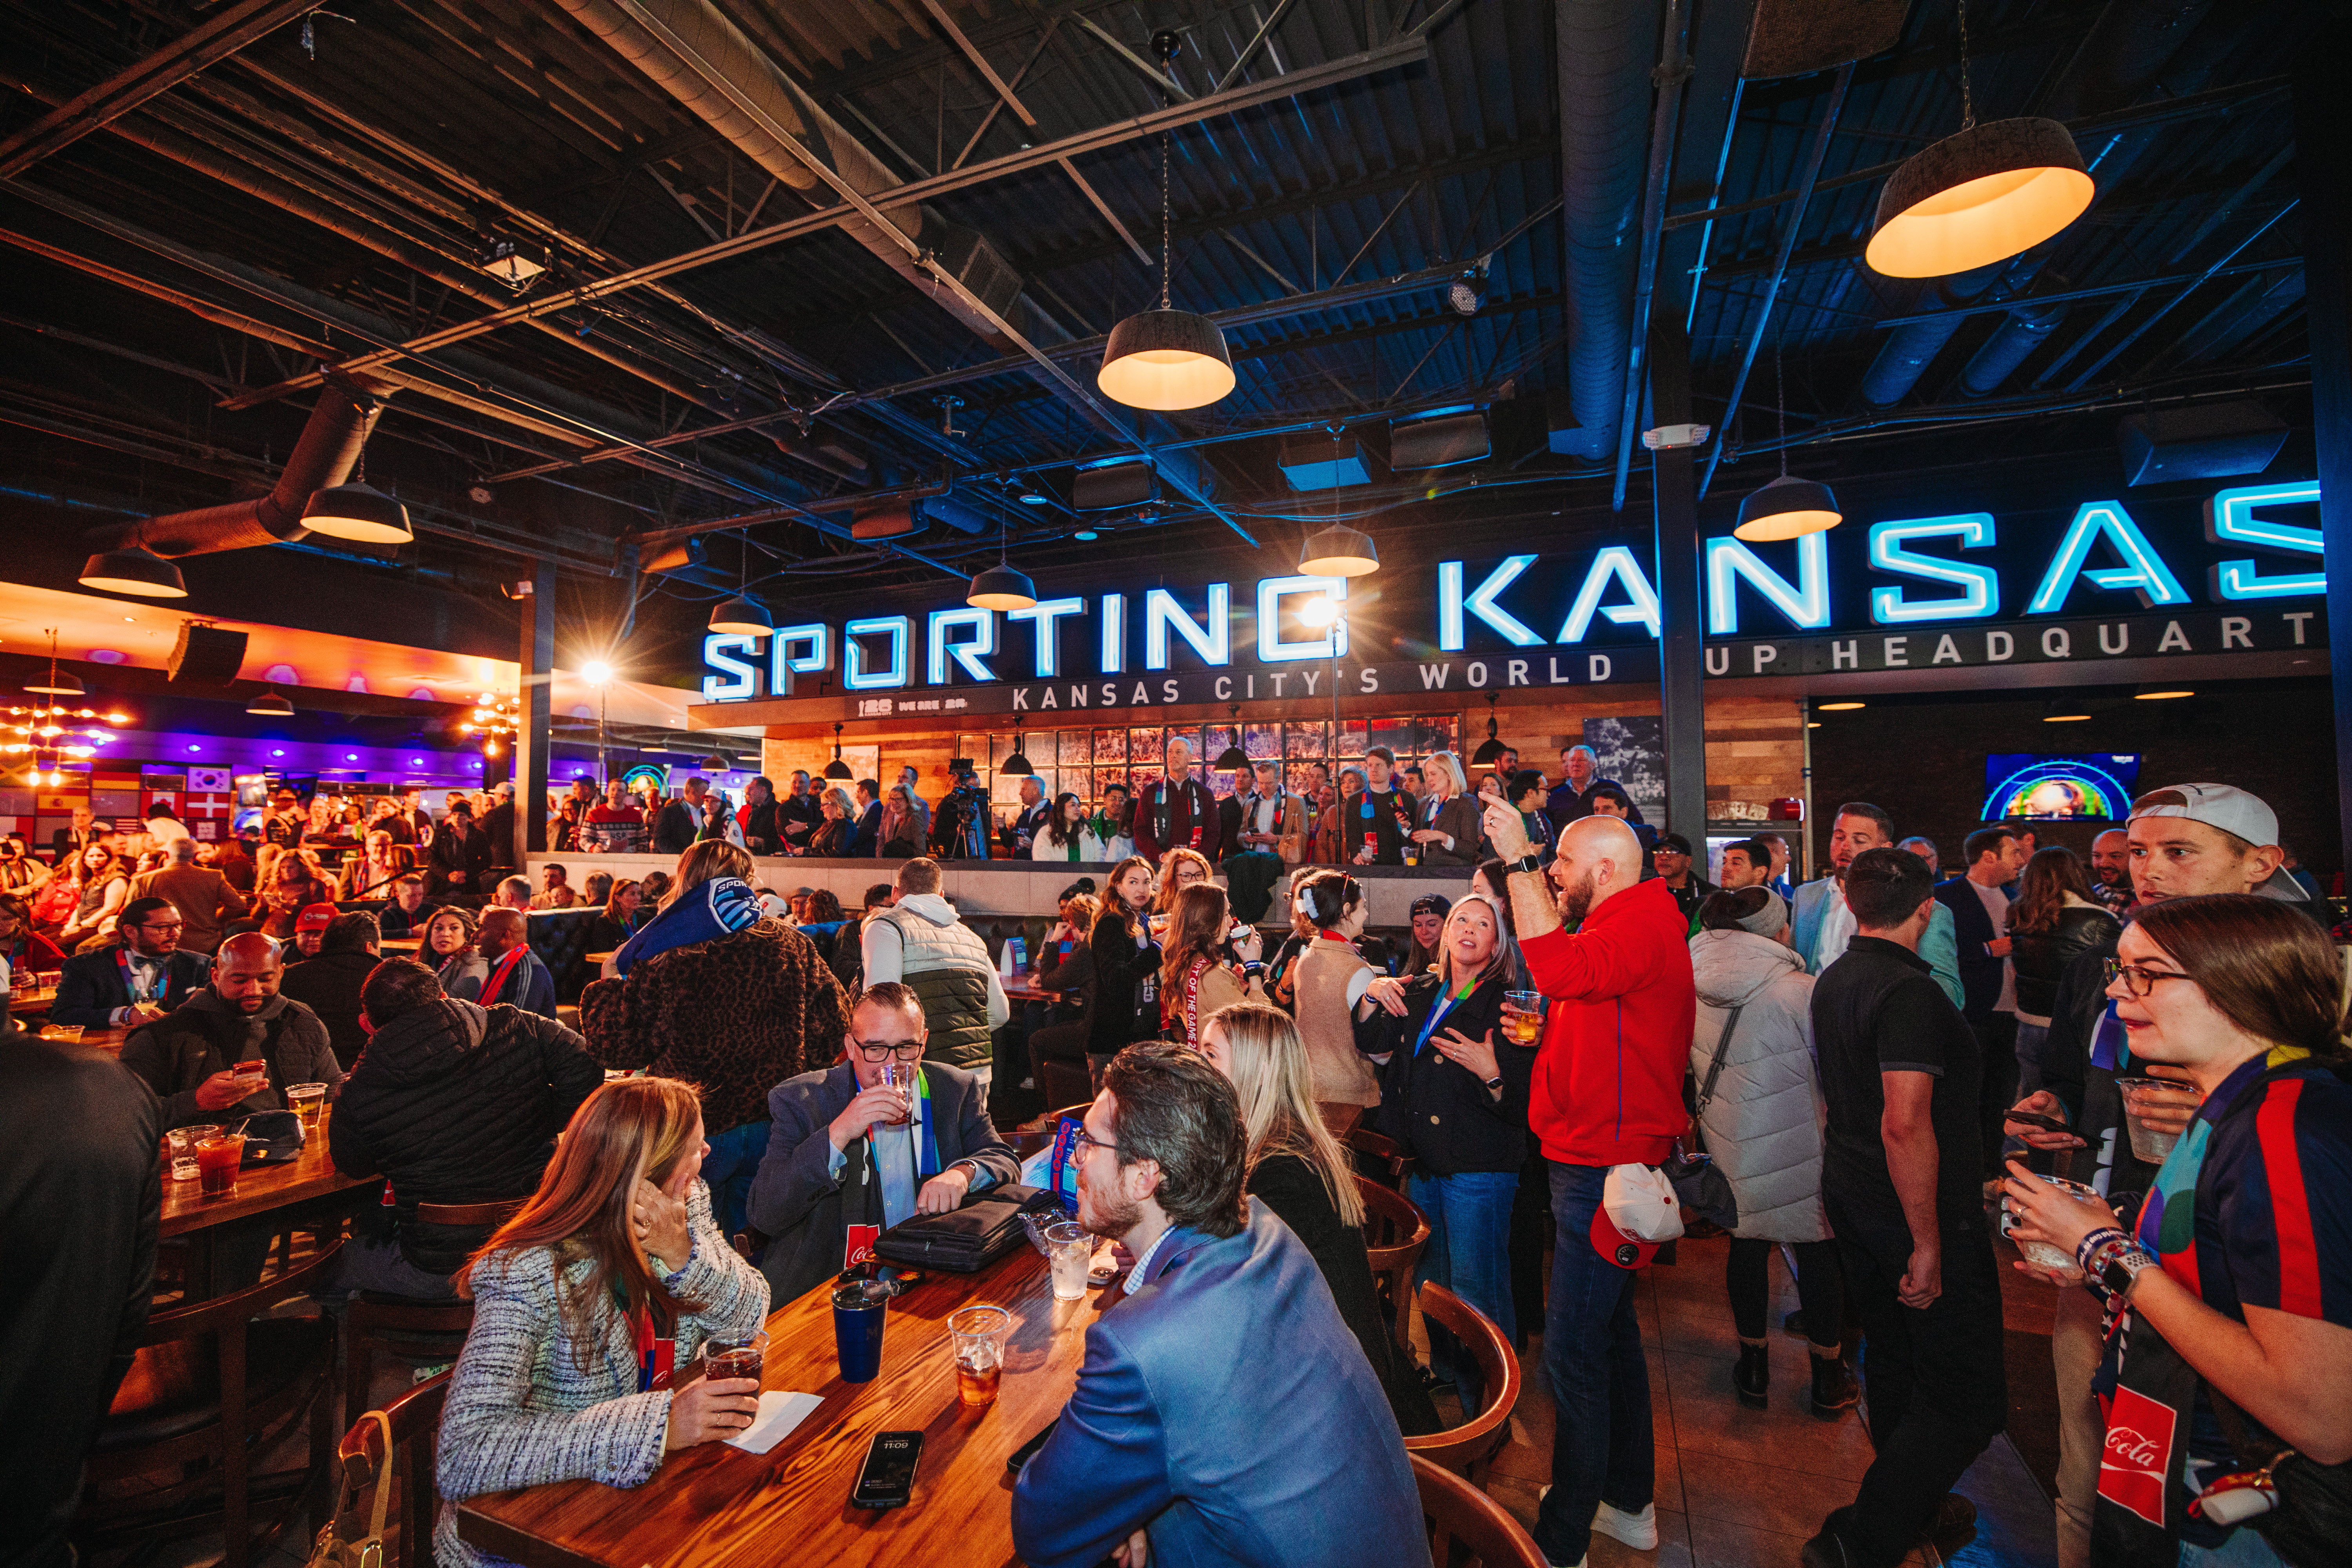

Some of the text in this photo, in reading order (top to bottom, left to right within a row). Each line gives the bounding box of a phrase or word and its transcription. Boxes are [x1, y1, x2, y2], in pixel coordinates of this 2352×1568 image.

[703, 480, 2328, 701] SPORTING KANSAS
[1014, 681, 1179, 710] KANSAS
[1215, 668, 1379, 700] CITY'S
[1420, 655, 1612, 690] WORLD
[1705, 646, 1778, 675] UP
[899, 701, 916, 711] WE
[917, 700, 939, 710] ARE
[718, 880, 750, 892] SPOR
[1189, 977, 1197, 992] OF
[1187, 995, 1196, 1012] THE
[1188, 1013, 1197, 1042] GAME
[2105, 1426, 2161, 1466] Cola
